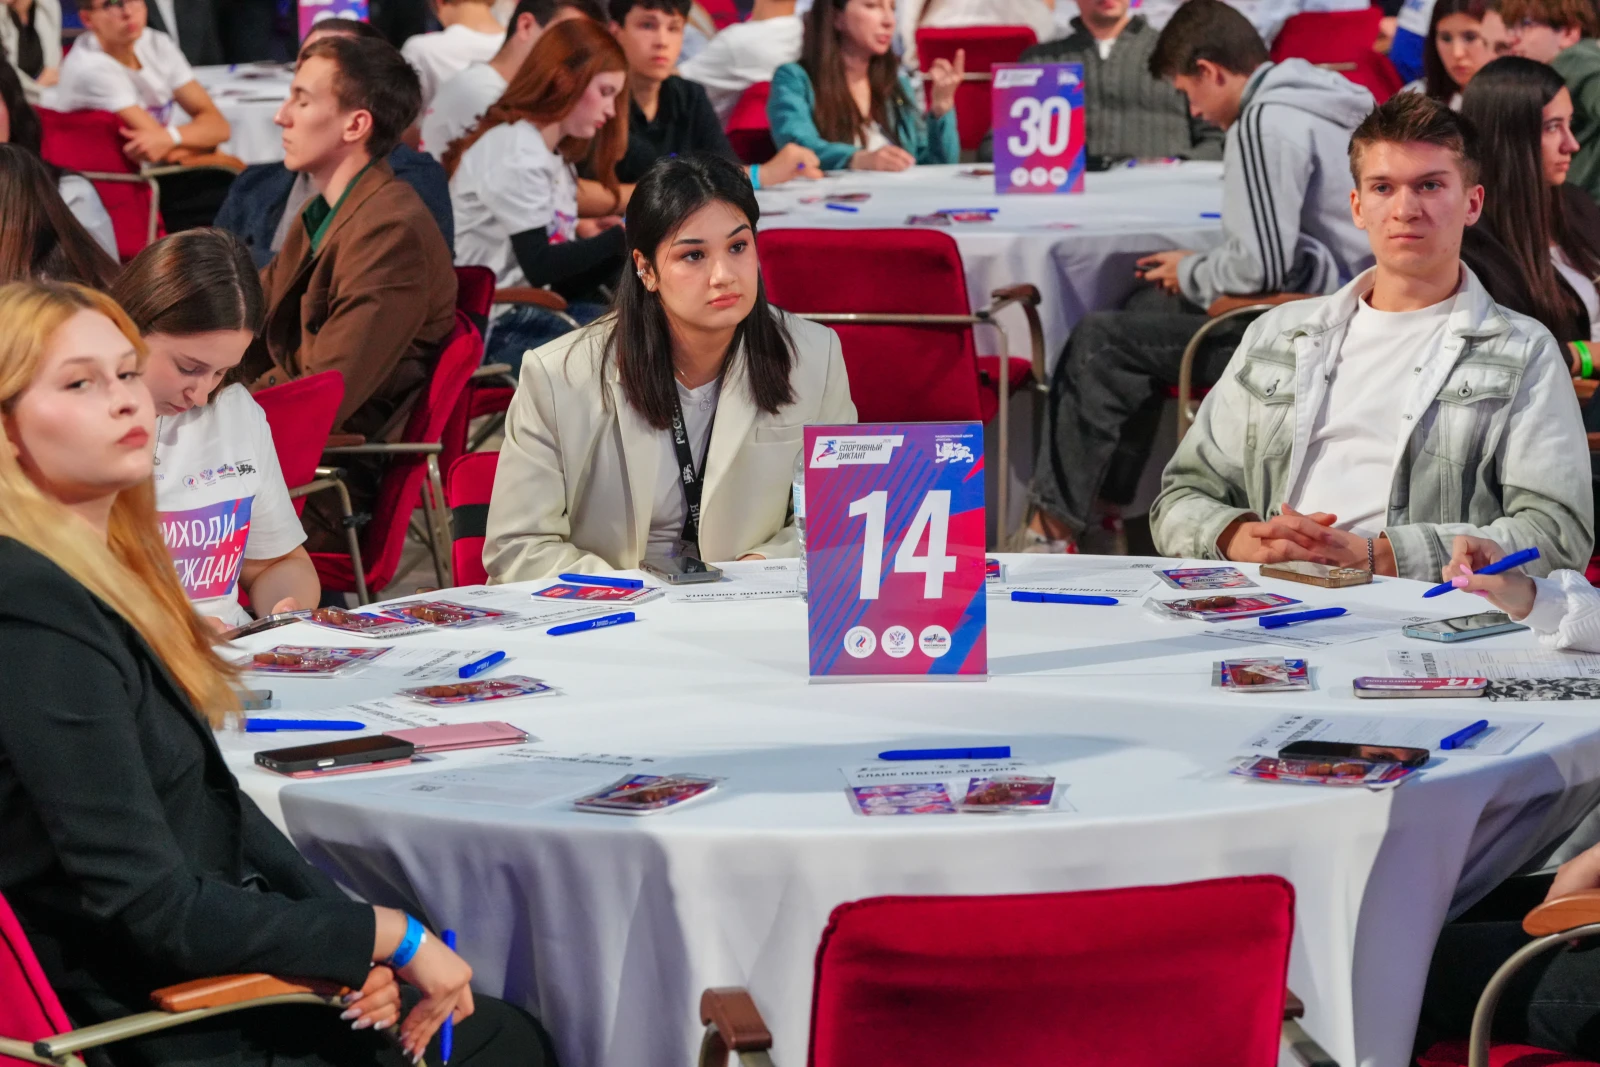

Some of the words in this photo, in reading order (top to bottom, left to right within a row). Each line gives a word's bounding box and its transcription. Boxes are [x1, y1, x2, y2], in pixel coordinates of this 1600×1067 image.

[1008, 95, 1071, 157] 30
[836, 451, 867, 461] ДИКТАНТ
[839, 442, 883, 452] СПОРТИВНЫЙ
[158, 512, 236, 551] ИХОДИ
[848, 490, 957, 600] 14
